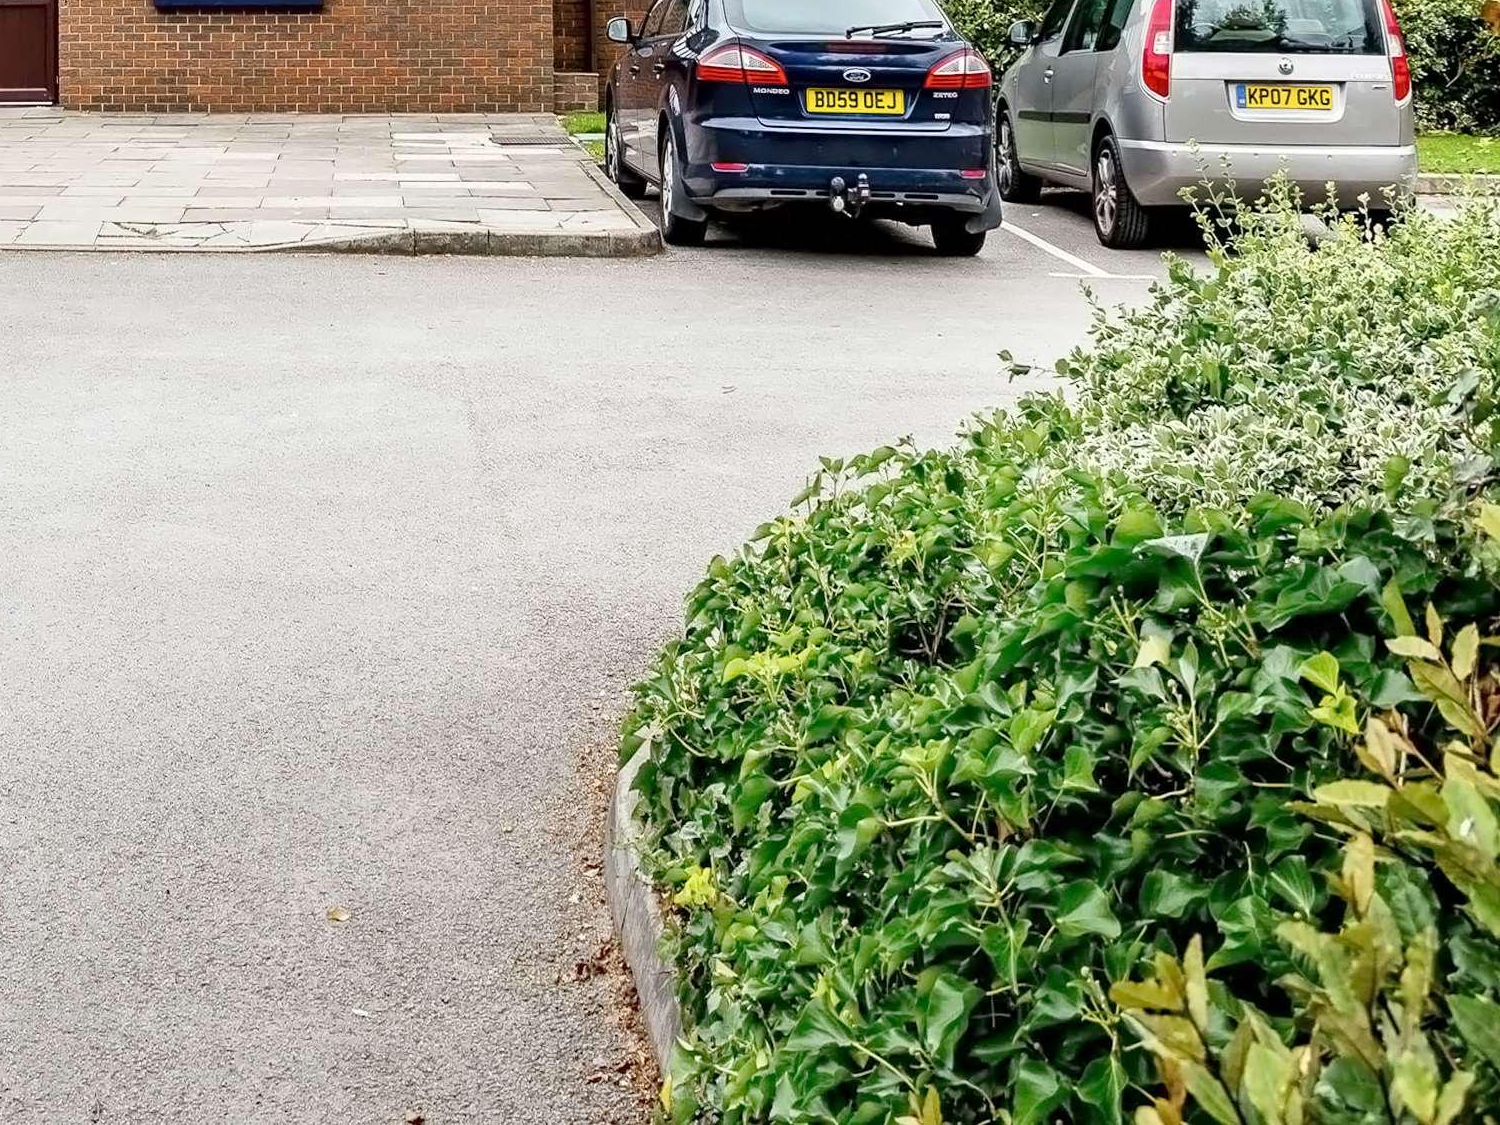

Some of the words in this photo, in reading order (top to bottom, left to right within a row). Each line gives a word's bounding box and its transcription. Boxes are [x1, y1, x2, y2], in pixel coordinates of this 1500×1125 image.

[814, 90, 859, 109] BD59
[863, 91, 897, 110] OEJ
[1248, 88, 1292, 105] KP07
[1297, 89, 1331, 106] GKG
